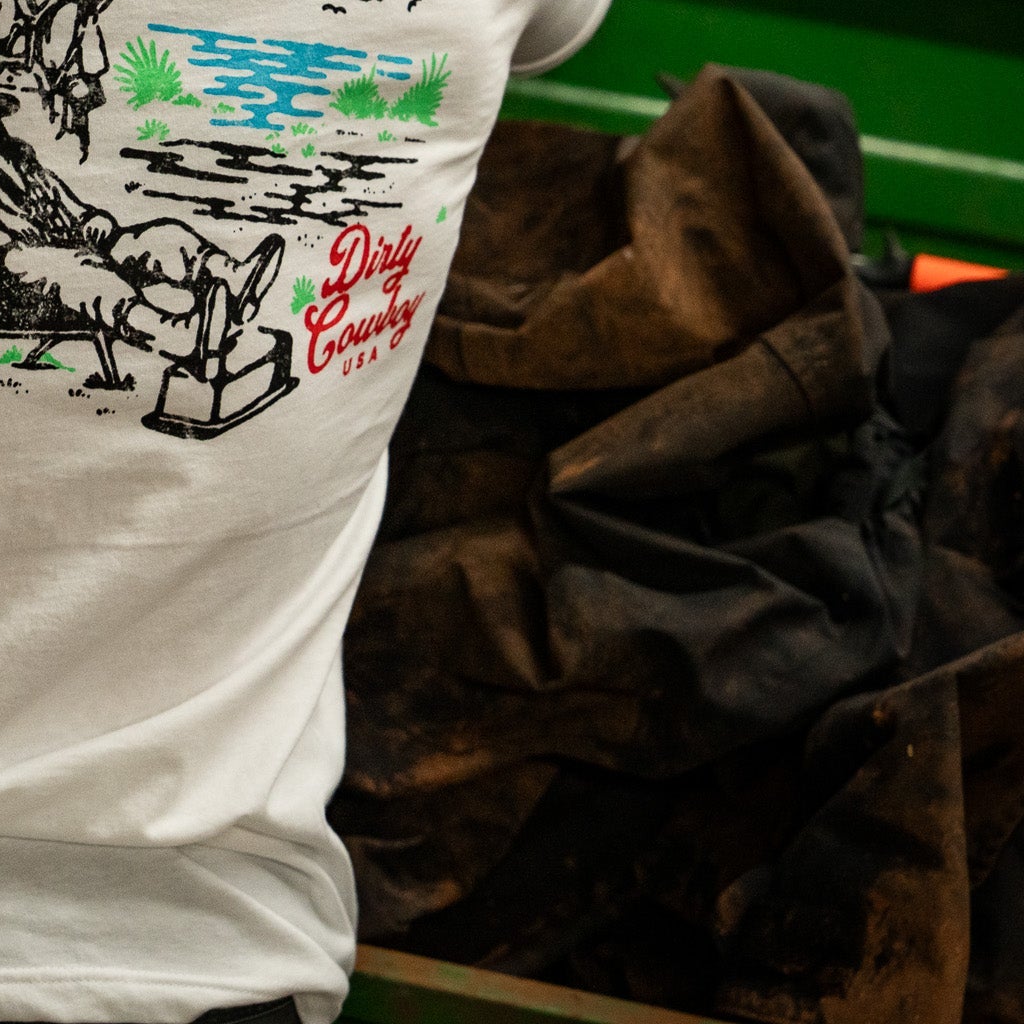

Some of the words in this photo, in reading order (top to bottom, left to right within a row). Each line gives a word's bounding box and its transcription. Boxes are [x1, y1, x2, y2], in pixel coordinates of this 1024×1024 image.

[320, 223, 423, 300] Dirty
[303, 283, 426, 375] Cowboy
[342, 345, 379, 377] USA
